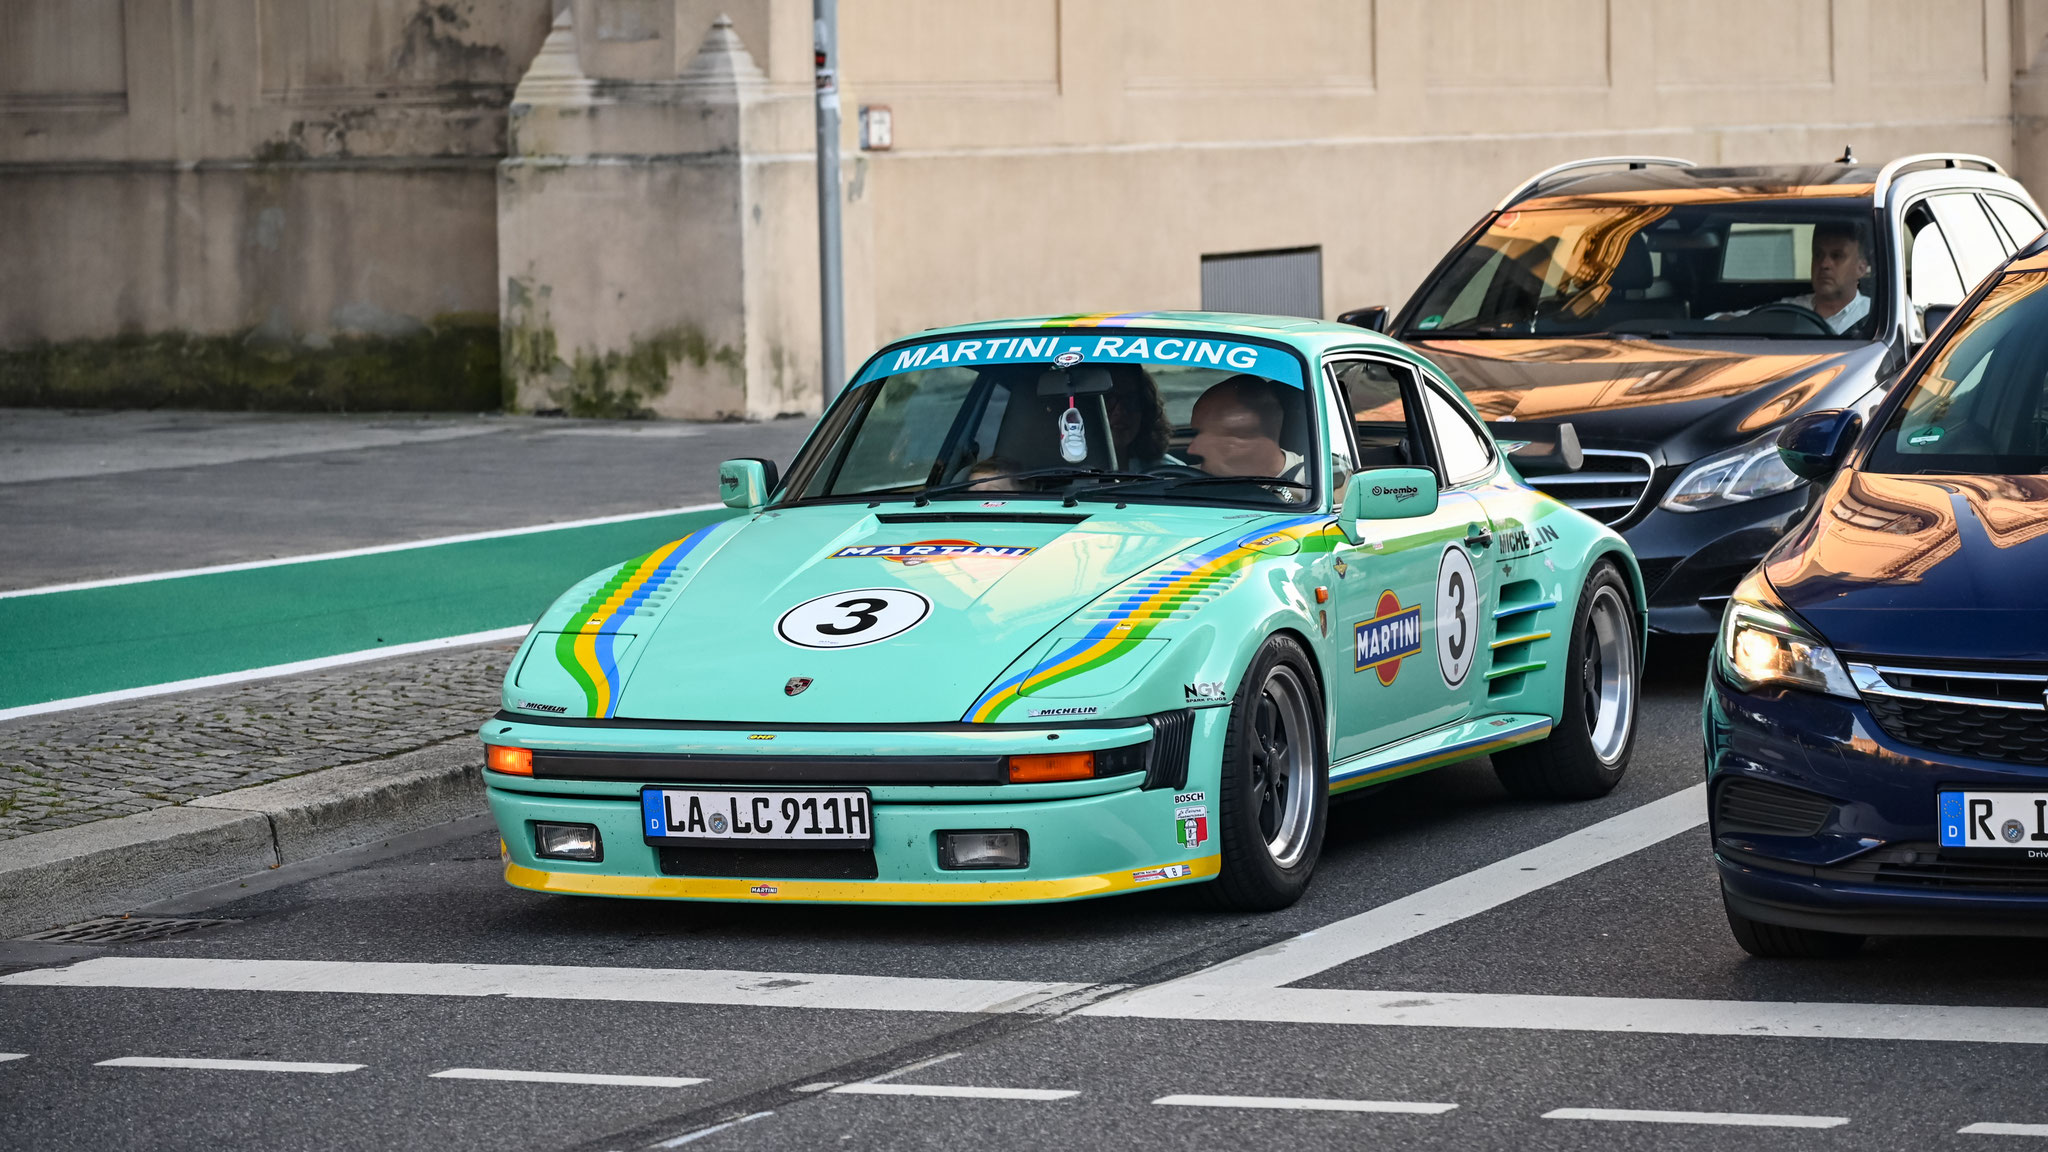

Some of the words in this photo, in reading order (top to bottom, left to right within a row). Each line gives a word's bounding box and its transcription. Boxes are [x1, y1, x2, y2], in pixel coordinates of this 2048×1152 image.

[892, 337, 1060, 371] MARTINI
[1093, 337, 1259, 369] RACING
[1383, 486, 1418, 495] brembo
[1499, 524, 1559, 555] MICHELIN
[838, 546, 1026, 557] MARTINI
[816, 598, 889, 635] 3
[1448, 571, 1467, 660] 3
[1357, 615, 1420, 662] MARTINI
[1183, 681, 1226, 699] NGK
[526, 702, 568, 713] MICHELIN
[1041, 707, 1097, 715] MICHELIN
[1174, 792, 1205, 804] BOSCH
[651, 818, 660, 829] D
[664, 795, 707, 833] LA
[730, 797, 773, 834] LC
[781, 797, 867, 834] 911H
[1969, 799, 1996, 840] R
[1948, 825, 1958, 838] D
